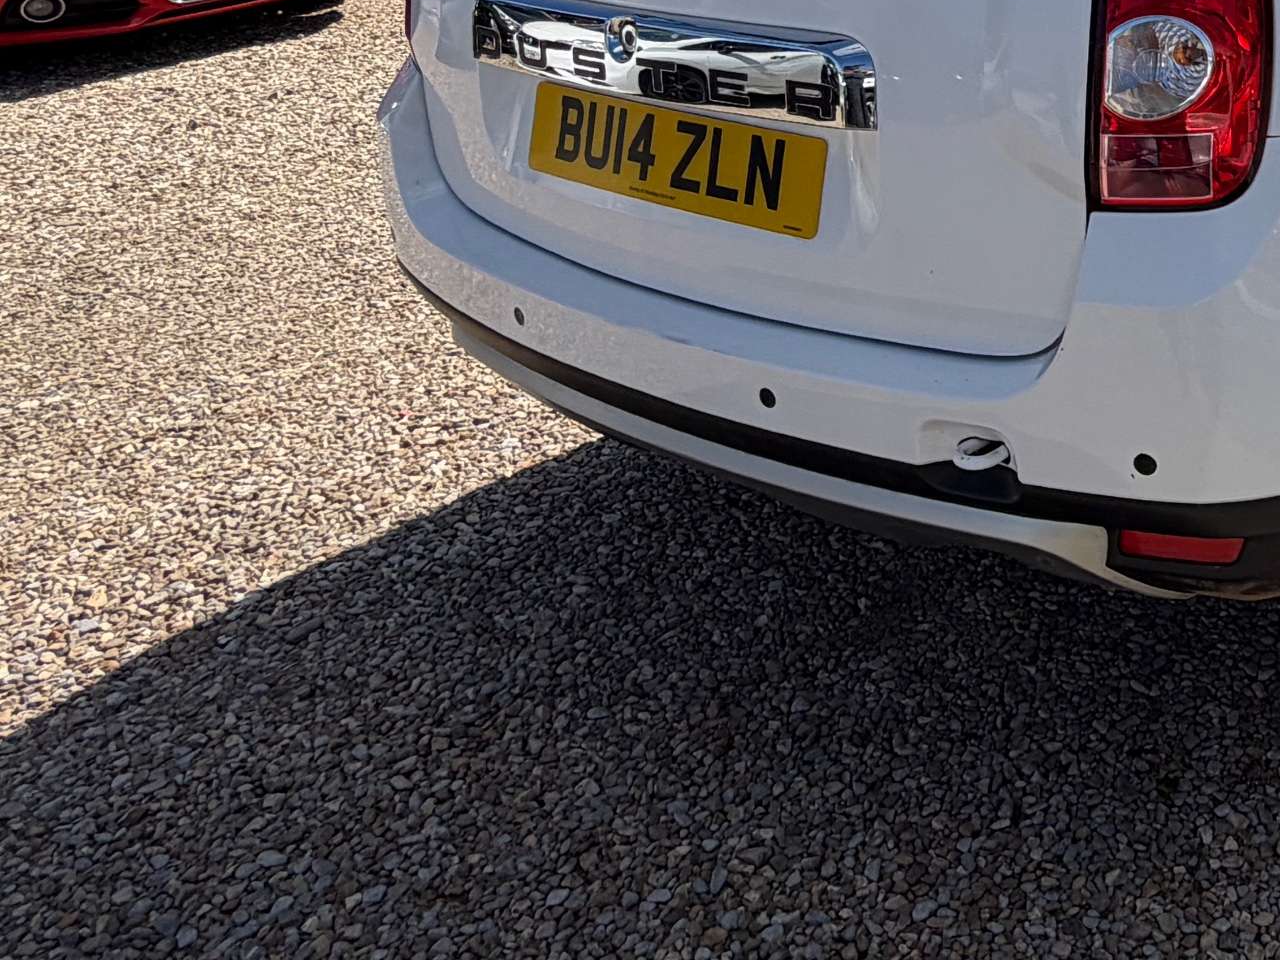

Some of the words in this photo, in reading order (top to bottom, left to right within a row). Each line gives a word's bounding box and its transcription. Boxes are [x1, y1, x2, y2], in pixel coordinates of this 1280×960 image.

[473, 24, 836, 121] DUSTER
[555, 95, 656, 181] BU14
[670, 120, 786, 211] ZLN
